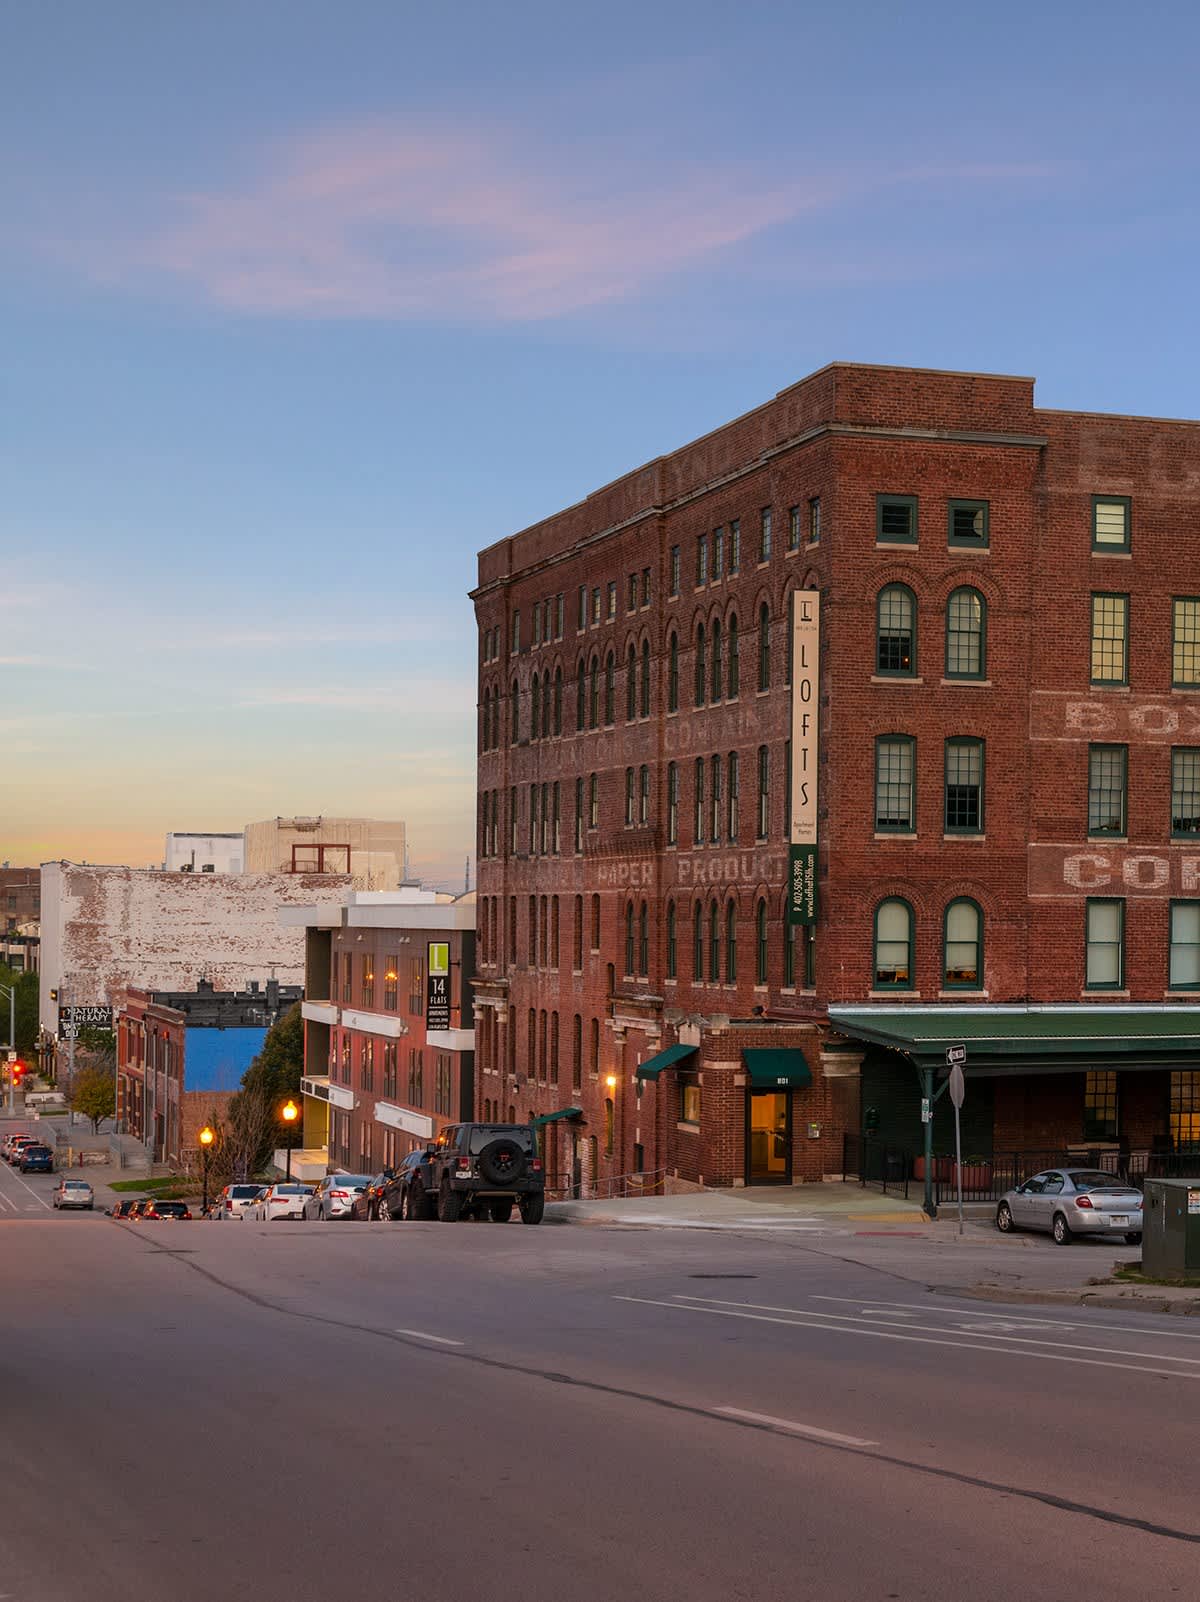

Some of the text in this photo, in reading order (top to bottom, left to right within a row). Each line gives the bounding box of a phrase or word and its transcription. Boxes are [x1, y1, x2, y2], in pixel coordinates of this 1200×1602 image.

[800, 644, 812, 807] LOFTS
[599, 862, 654, 886] PAPER
[432, 978, 446, 995] 14
[430, 996, 447, 1005] FLATS
